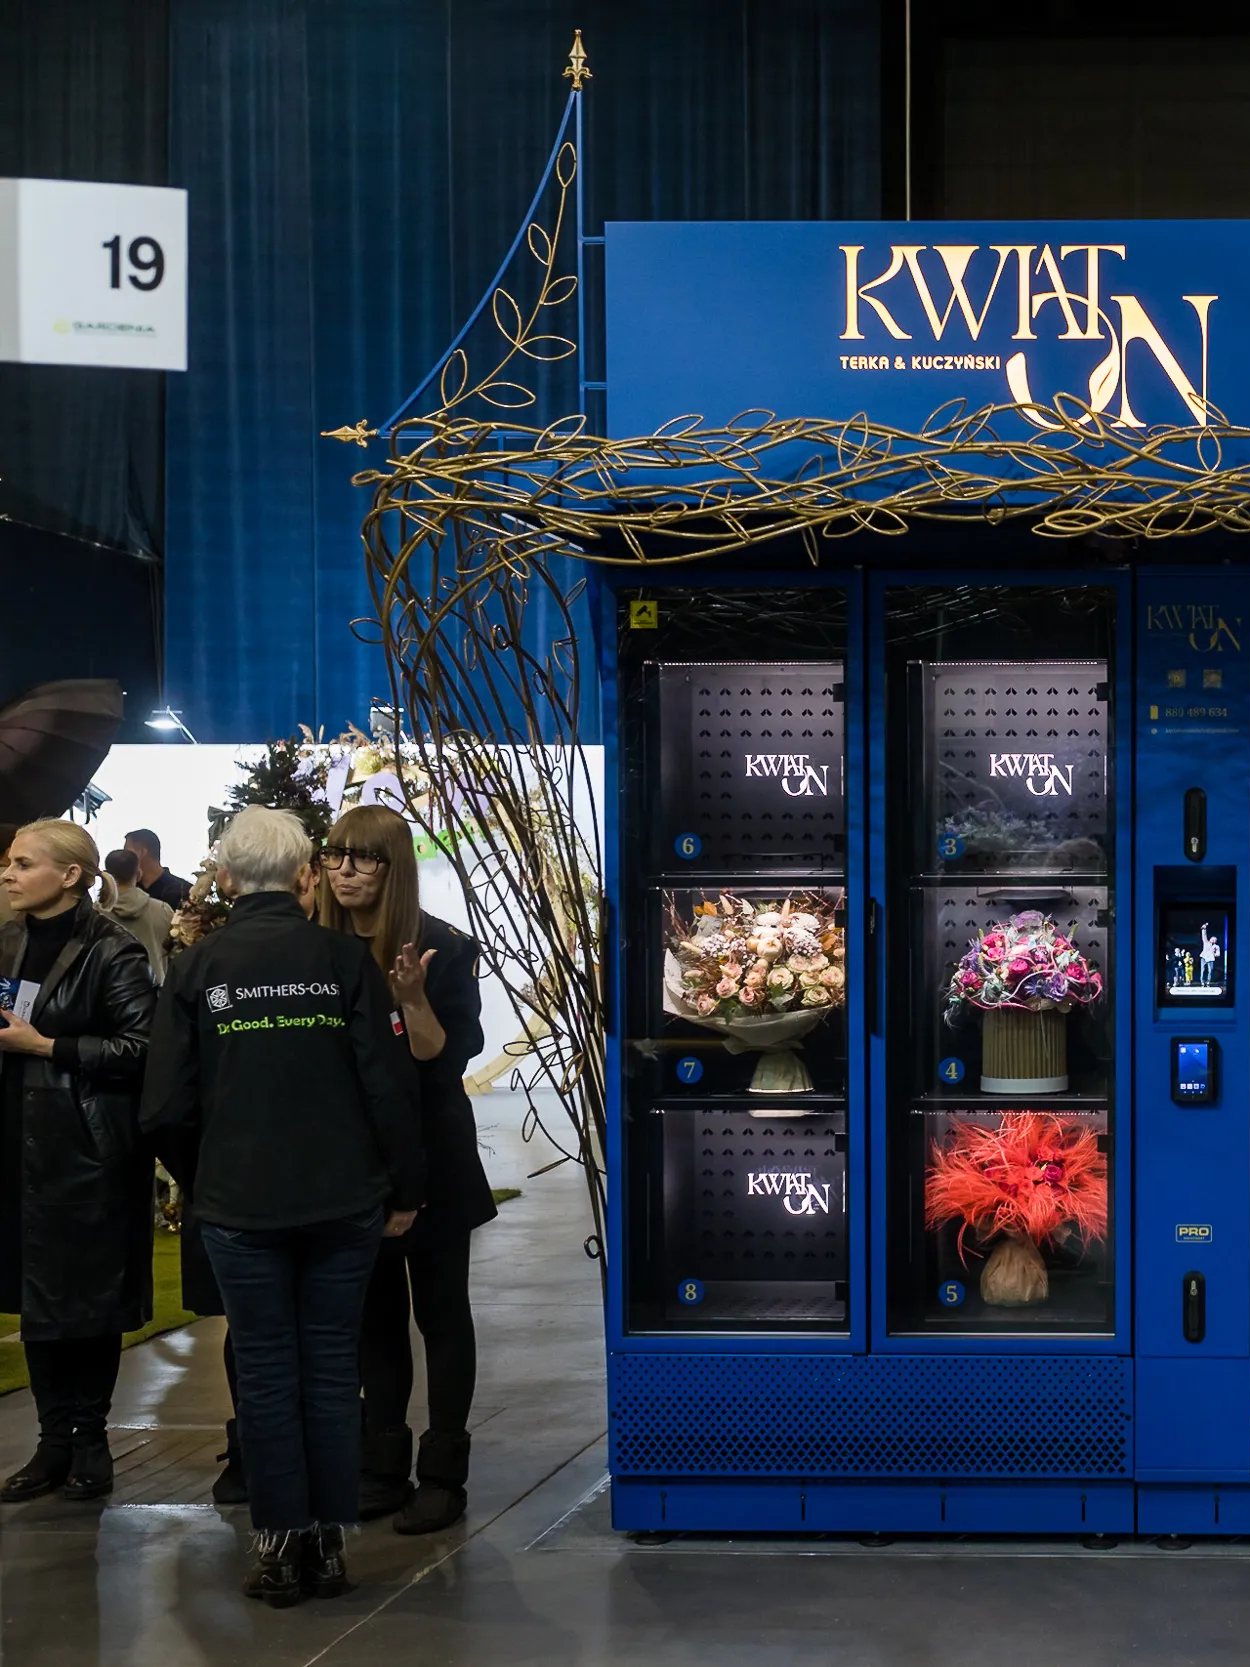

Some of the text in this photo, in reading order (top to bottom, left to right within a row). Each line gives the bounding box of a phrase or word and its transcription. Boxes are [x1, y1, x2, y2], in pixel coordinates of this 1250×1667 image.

[102, 234, 165, 291] 19
[839, 353, 1001, 370] TERKA & KUCZYŃSKI
[681, 837, 695, 856] 6
[944, 837, 958, 856] 3
[231, 1016, 274, 1031] Good.
[276, 1015, 315, 1028] Every
[683, 1061, 696, 1081] 7
[945, 1061, 958, 1081] 4
[1179, 1226, 1210, 1237] PRO
[684, 1282, 698, 1302] 8
[945, 1284, 959, 1303] 5
